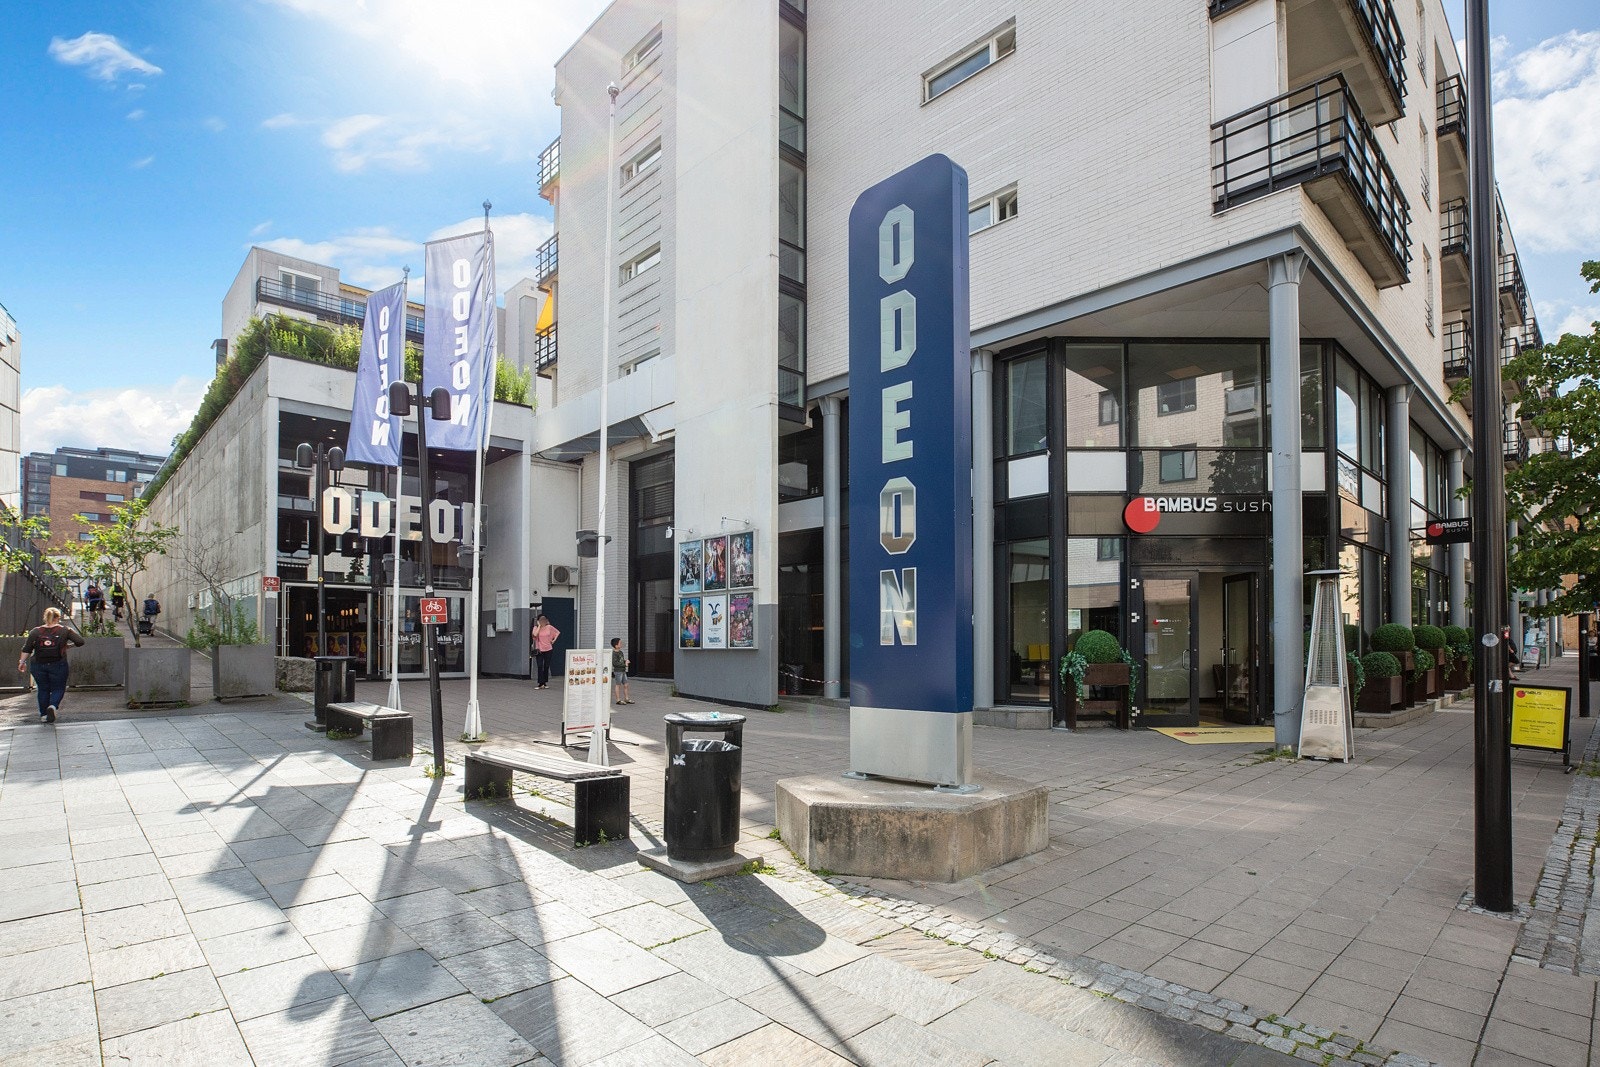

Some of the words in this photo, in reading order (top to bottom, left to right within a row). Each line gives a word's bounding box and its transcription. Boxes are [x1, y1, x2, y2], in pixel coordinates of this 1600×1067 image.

[878, 203, 918, 647] ODEON
[1144, 497, 1217, 512] BAMBUS
[1223, 499, 1272, 512] sush
[1435, 520, 1469, 529] BAMBUS
